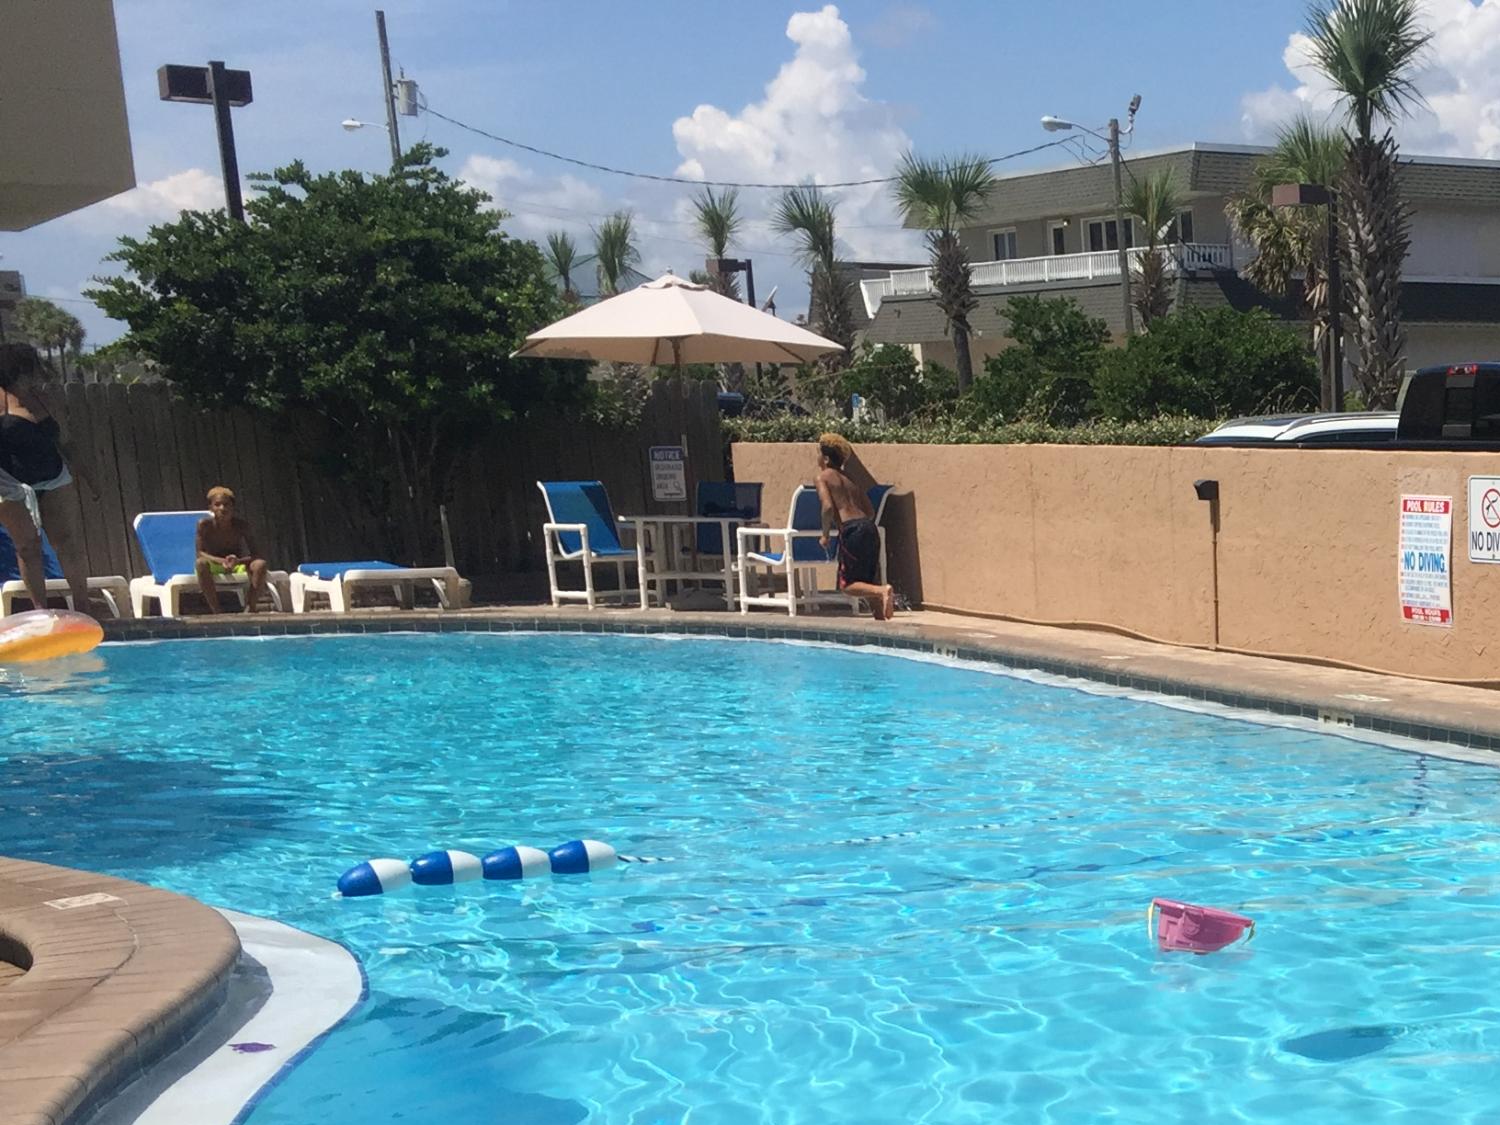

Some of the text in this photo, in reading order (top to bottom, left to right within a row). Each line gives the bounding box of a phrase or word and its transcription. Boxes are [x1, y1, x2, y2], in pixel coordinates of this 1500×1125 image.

[1406, 500, 1445, 513] POOL RULES
[1472, 531, 1485, 551] NO
[1404, 551, 1416, 570] NO
